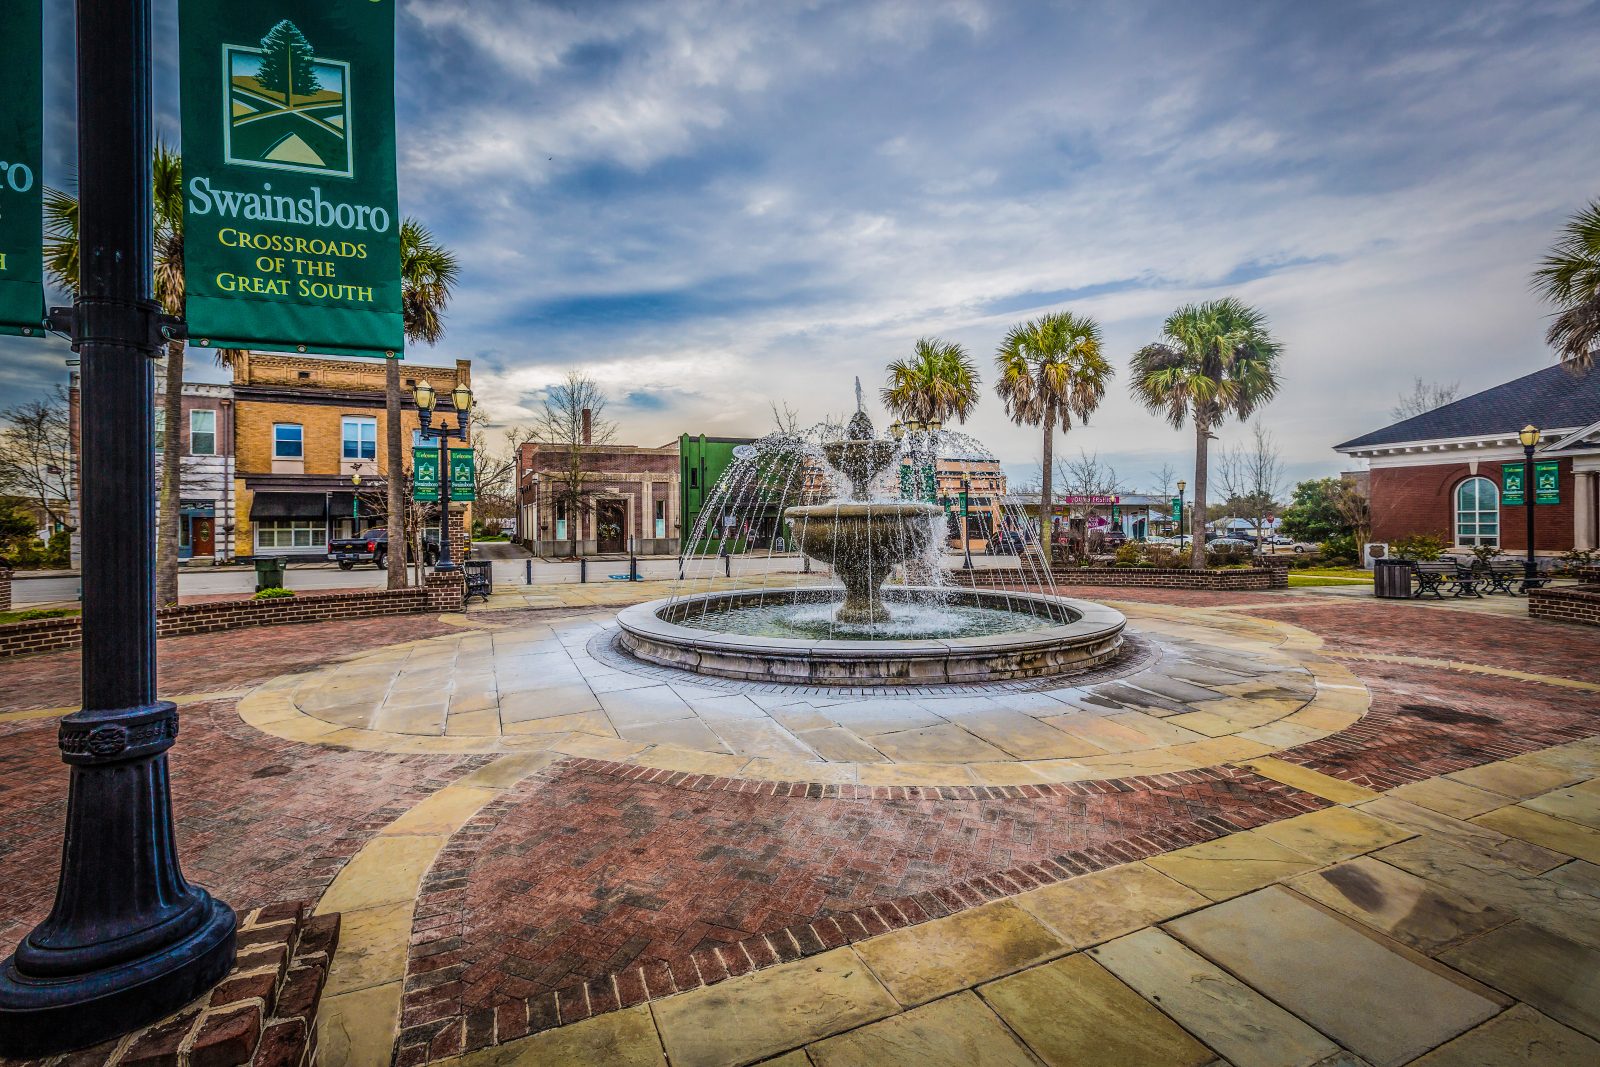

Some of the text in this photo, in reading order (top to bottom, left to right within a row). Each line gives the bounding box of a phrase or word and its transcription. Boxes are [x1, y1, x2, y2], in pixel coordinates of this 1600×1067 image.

[188, 176, 390, 233] Swainsboro
[218, 228, 368, 260] CROSSROADS
[256, 256, 336, 278] OF THE
[216, 272, 374, 302] GREAT SOUTH
